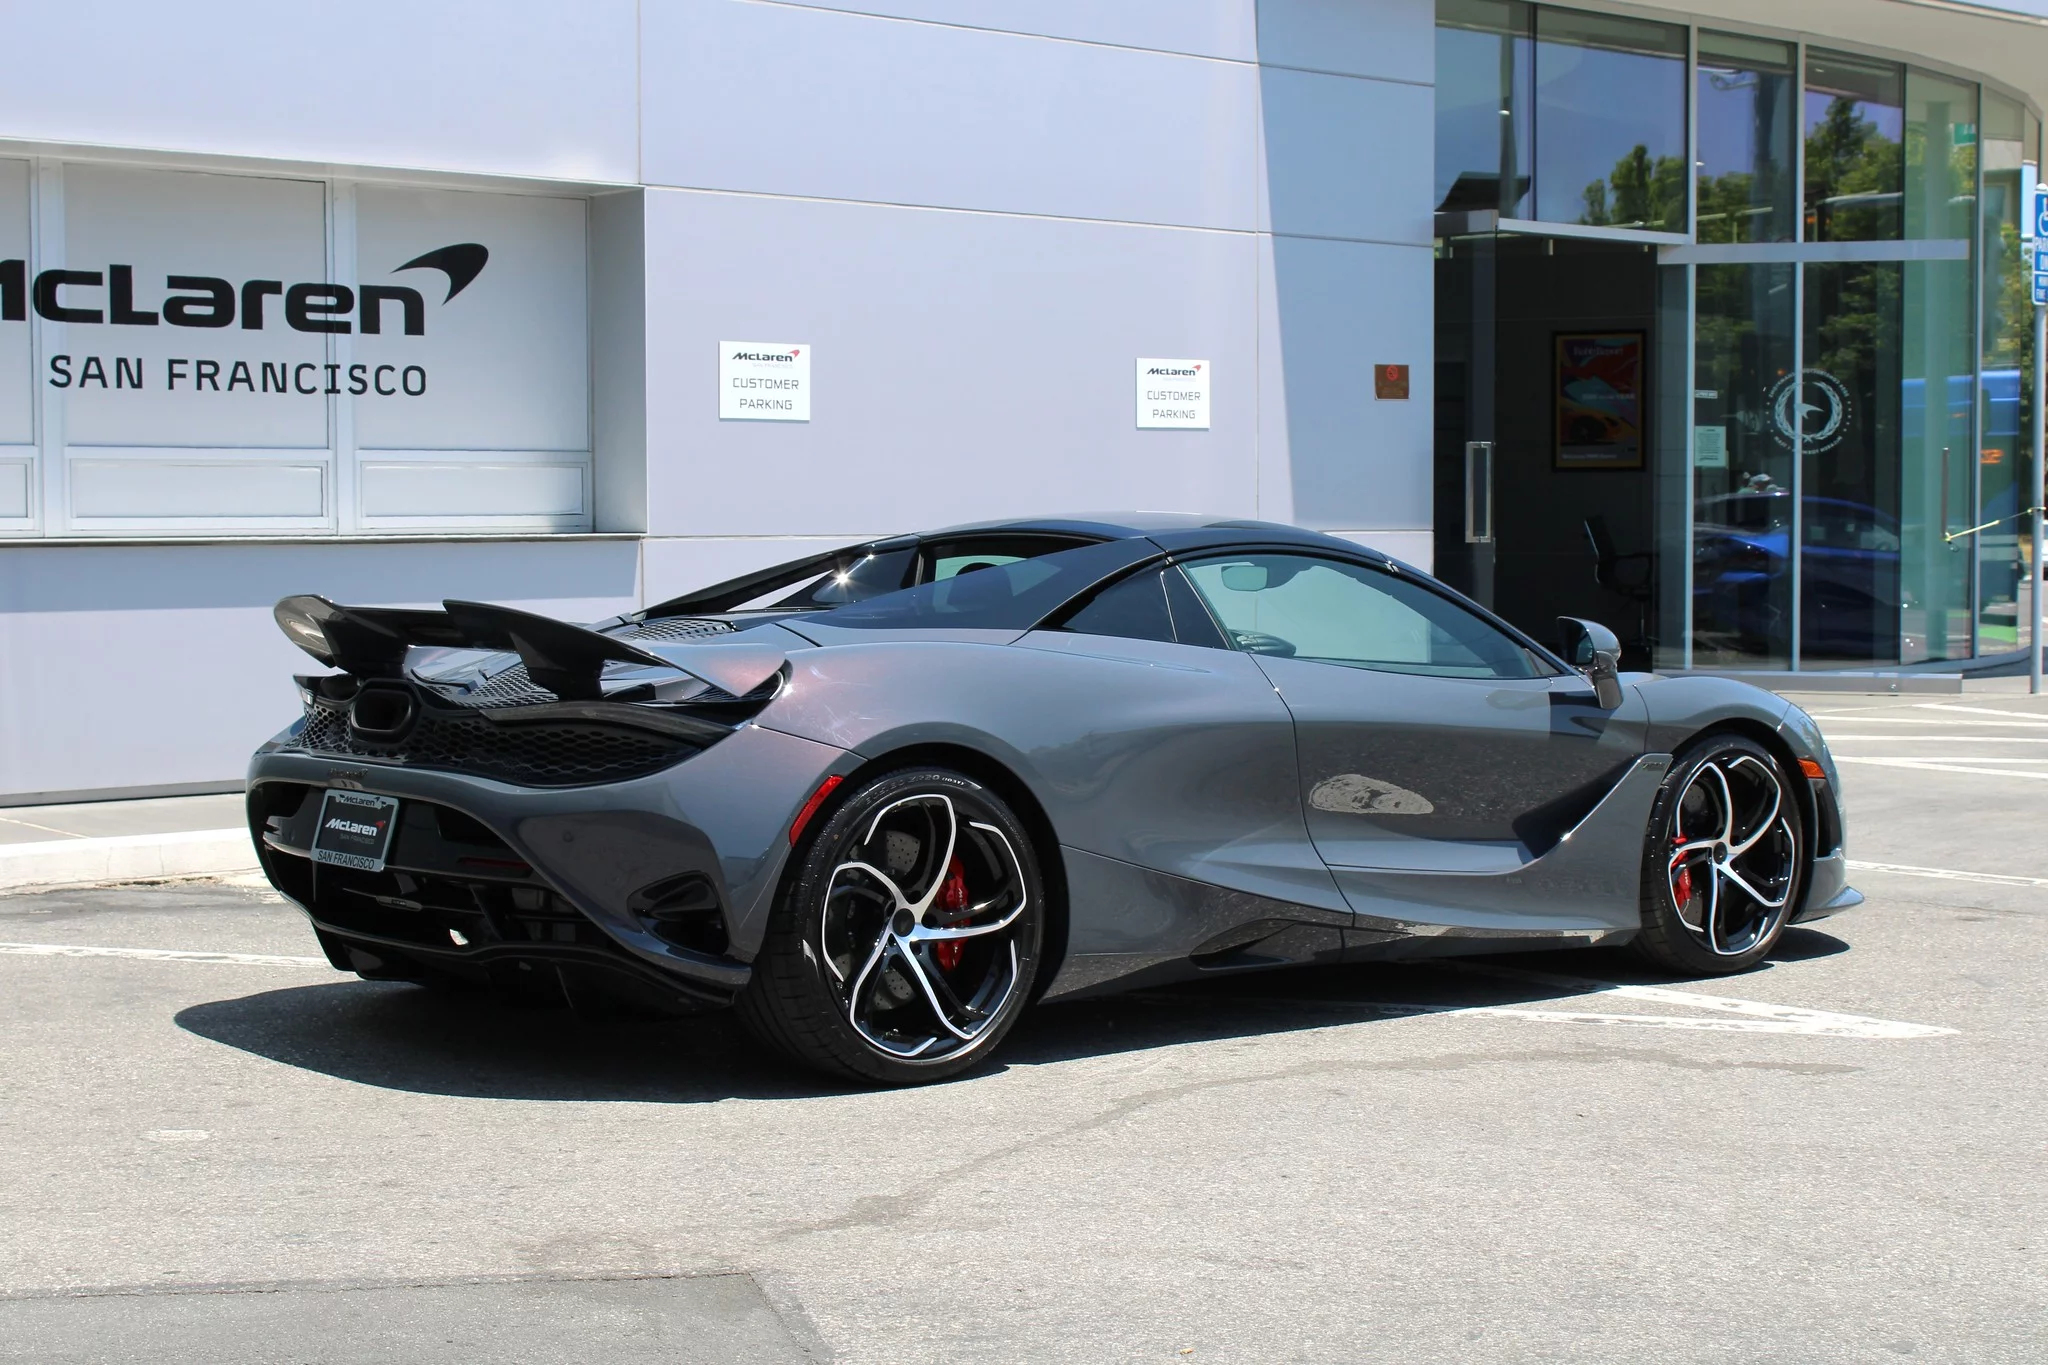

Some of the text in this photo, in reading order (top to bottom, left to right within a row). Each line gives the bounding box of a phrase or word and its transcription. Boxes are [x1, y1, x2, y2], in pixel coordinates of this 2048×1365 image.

[0, 259, 425, 336] cLaren
[732, 352, 793, 362] McLaren
[49, 354, 427, 397] SAN FRANCISCO
[1147, 368, 1196, 376] McLaren
[732, 377, 799, 390] CUSTOMER
[1147, 390, 1201, 401] CUSTOMER
[739, 398, 793, 410] PARKING
[1152, 408, 1196, 419] PARKING
[344, 796, 375, 806] McLaren
[325, 818, 378, 836] McLaren
[317, 850, 375, 870] SAN FRANCISCO
